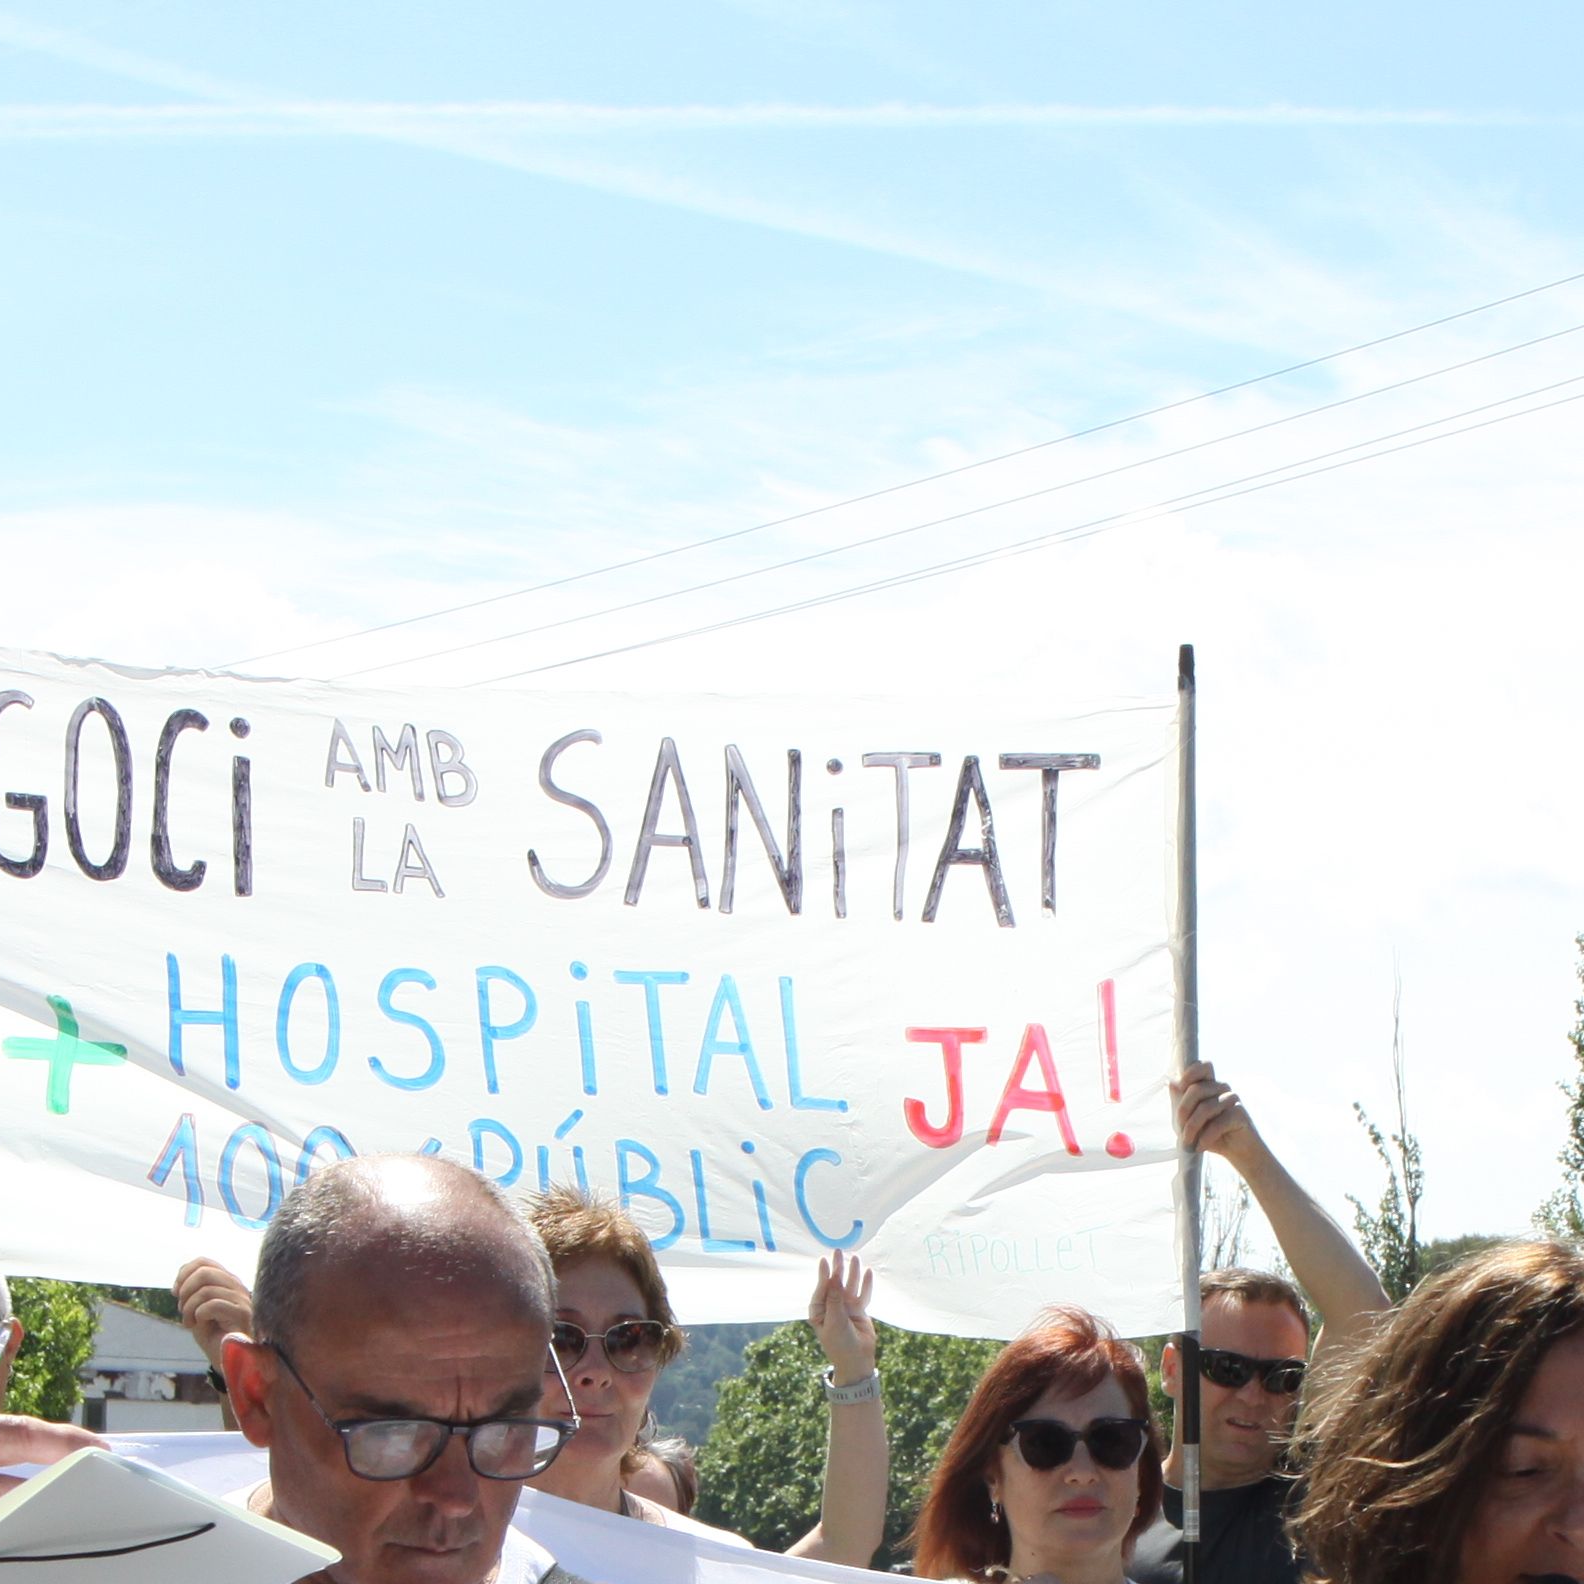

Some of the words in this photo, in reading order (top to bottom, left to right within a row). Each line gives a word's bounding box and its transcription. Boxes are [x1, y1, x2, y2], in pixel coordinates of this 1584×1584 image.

[325, 718, 479, 809] AMB
[351, 816, 446, 900] LA
[904, 978, 1137, 1160] JA!
